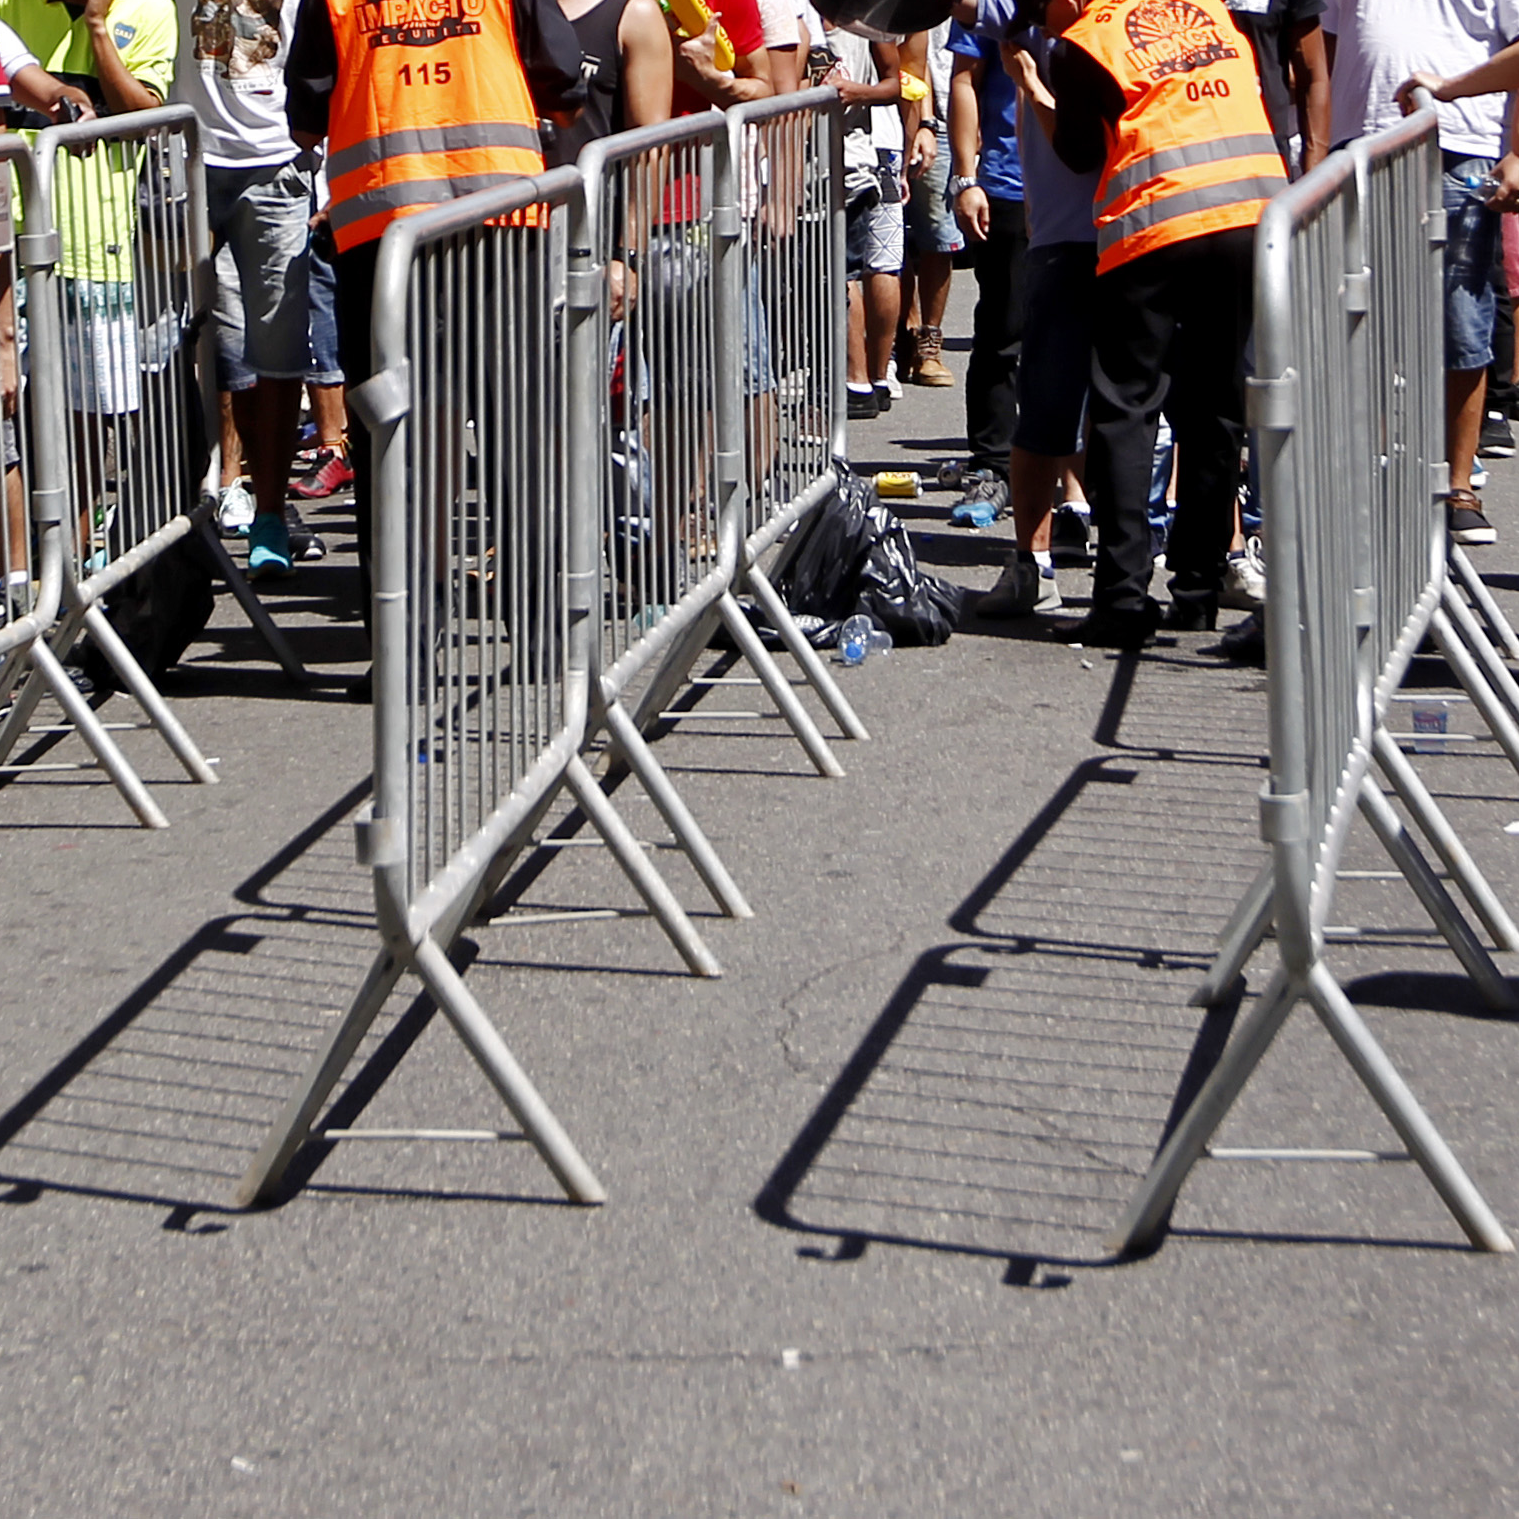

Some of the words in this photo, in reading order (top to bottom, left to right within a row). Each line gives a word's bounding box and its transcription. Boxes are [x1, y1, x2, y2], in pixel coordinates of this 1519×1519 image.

[372, 23, 479, 45] ECURITY
[1125, 23, 1234, 72] IMPACTO
[398, 62, 451, 86] 115
[1186, 79, 1230, 101] 040
